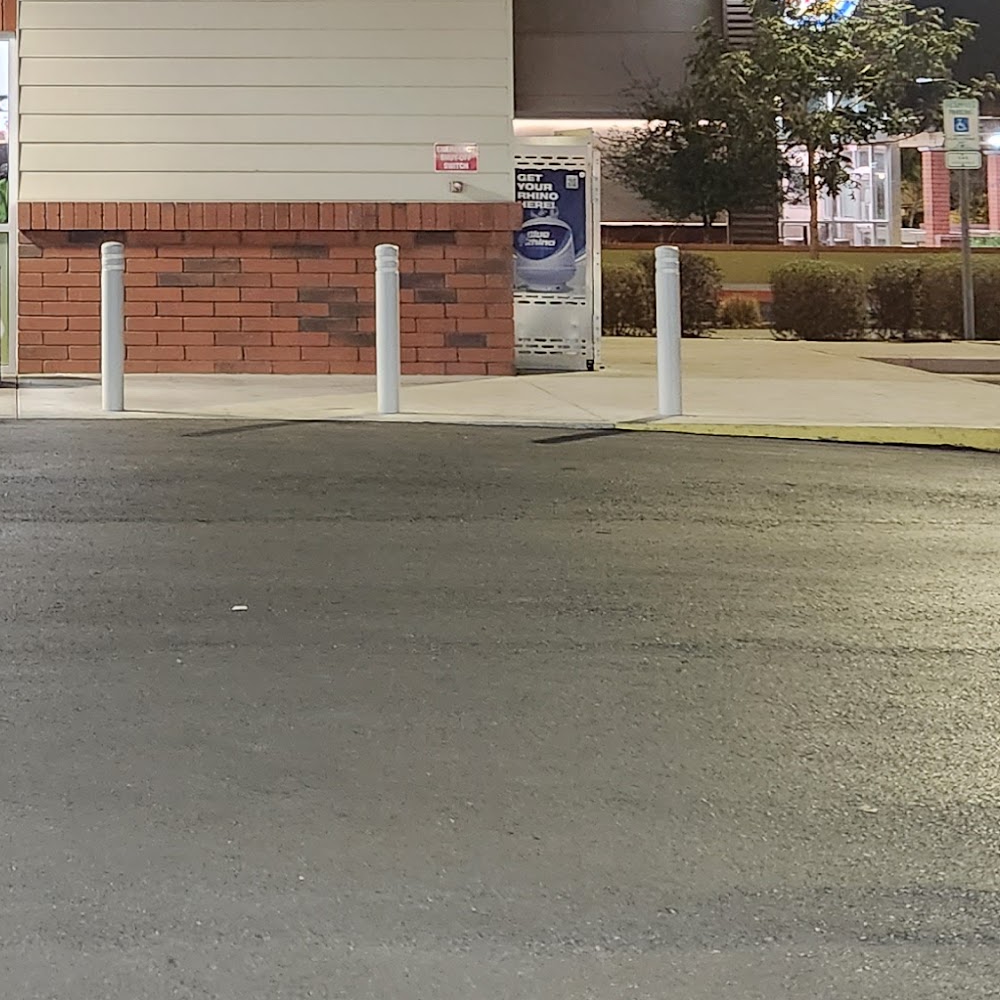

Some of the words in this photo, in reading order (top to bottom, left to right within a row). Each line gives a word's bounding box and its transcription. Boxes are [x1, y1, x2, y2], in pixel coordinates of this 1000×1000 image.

[517, 174, 543, 182] GET
[517, 183, 553, 191] YOUR
[517, 192, 559, 200] RHINO
